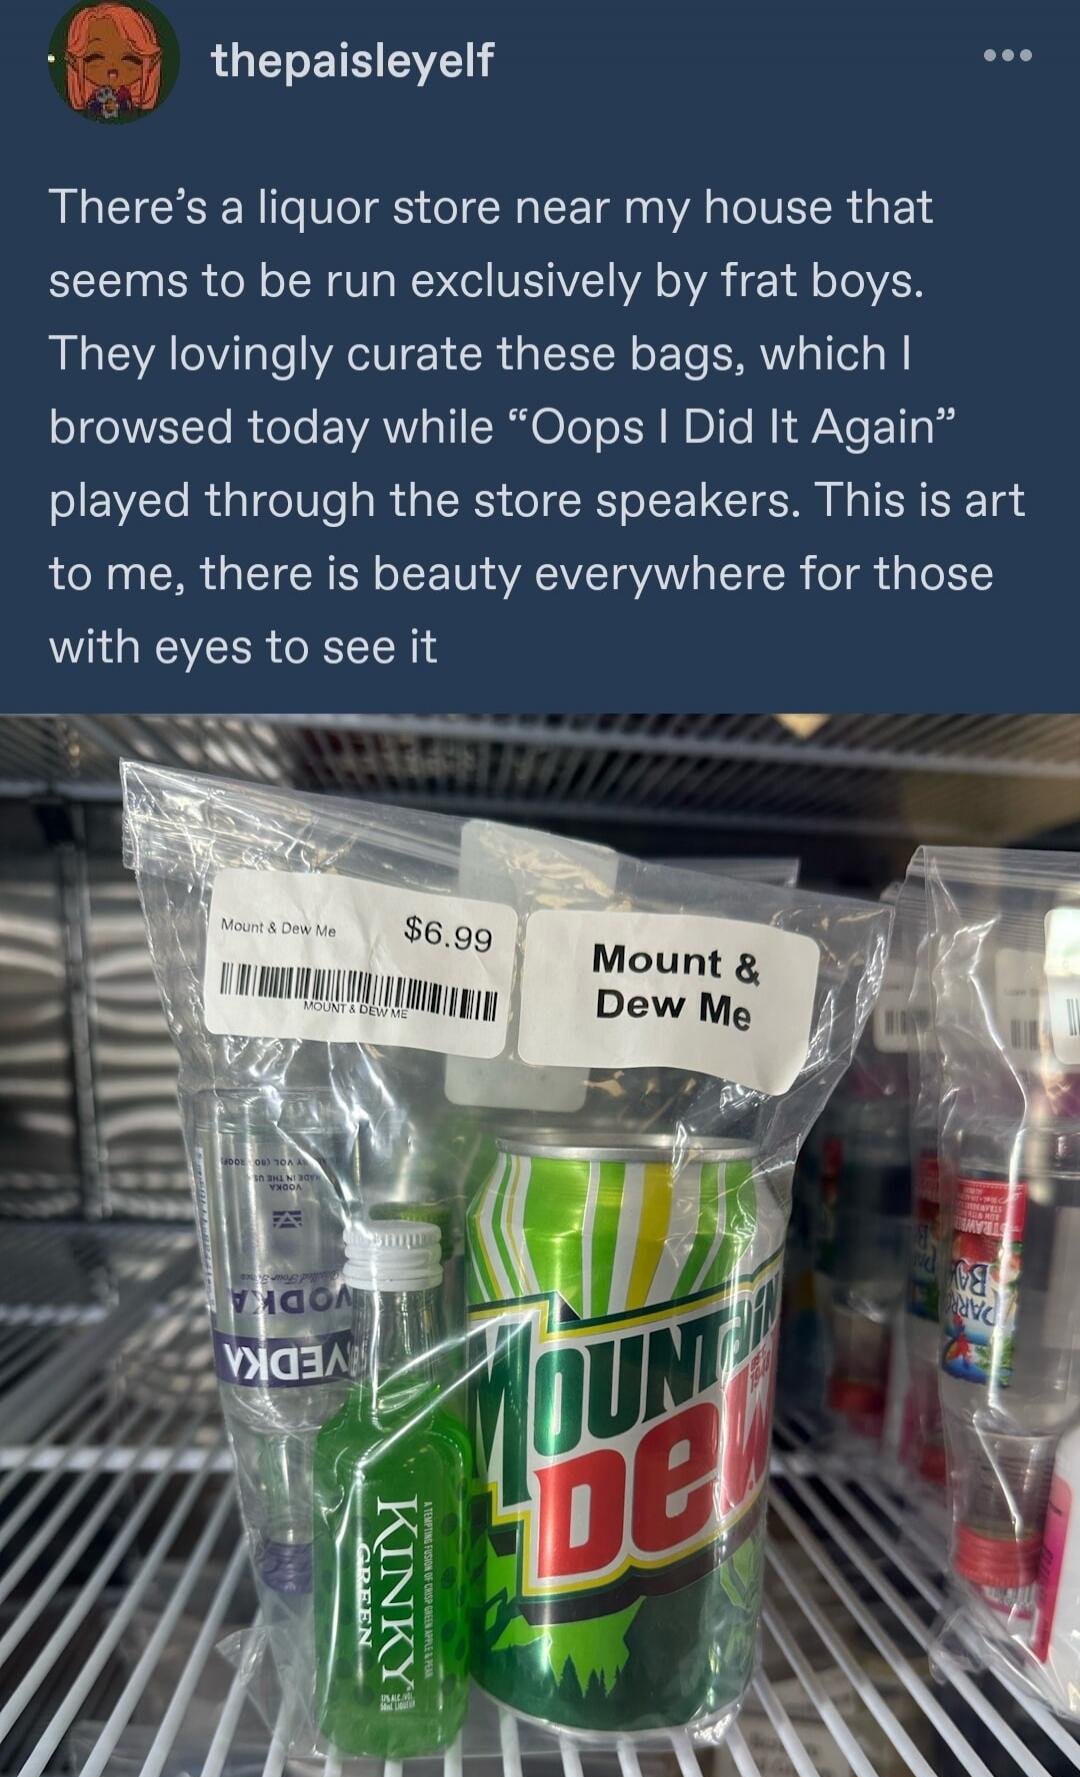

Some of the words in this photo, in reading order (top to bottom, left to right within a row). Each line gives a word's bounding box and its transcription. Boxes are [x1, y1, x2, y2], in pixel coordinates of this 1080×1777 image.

[221, 918, 264, 935] Mount
[267, 922, 277, 935] &
[281, 922, 312, 936] Dew
[315, 925, 337, 938] Me
[403, 914, 493, 953] $6.99
[591, 942, 721, 978] Mount
[734, 953, 761, 987] &
[596, 988, 686, 1020] Dew
[698, 992, 752, 1031] Me
[231, 1283, 353, 1316] VODKA
[223, 1341, 354, 1382] VEDKA
[423, 1508, 433, 1544] TEMPTING
[423, 1545, 433, 1572] FUSION
[373, 1494, 418, 1690] KINKY
[423, 1573, 433, 1582] OF
[423, 1583, 433, 1604] CRISP
[357, 1542, 373, 1648] GREEN
[423, 1605, 433, 1629] GREEN
[423, 1629, 433, 1652] APPLE
